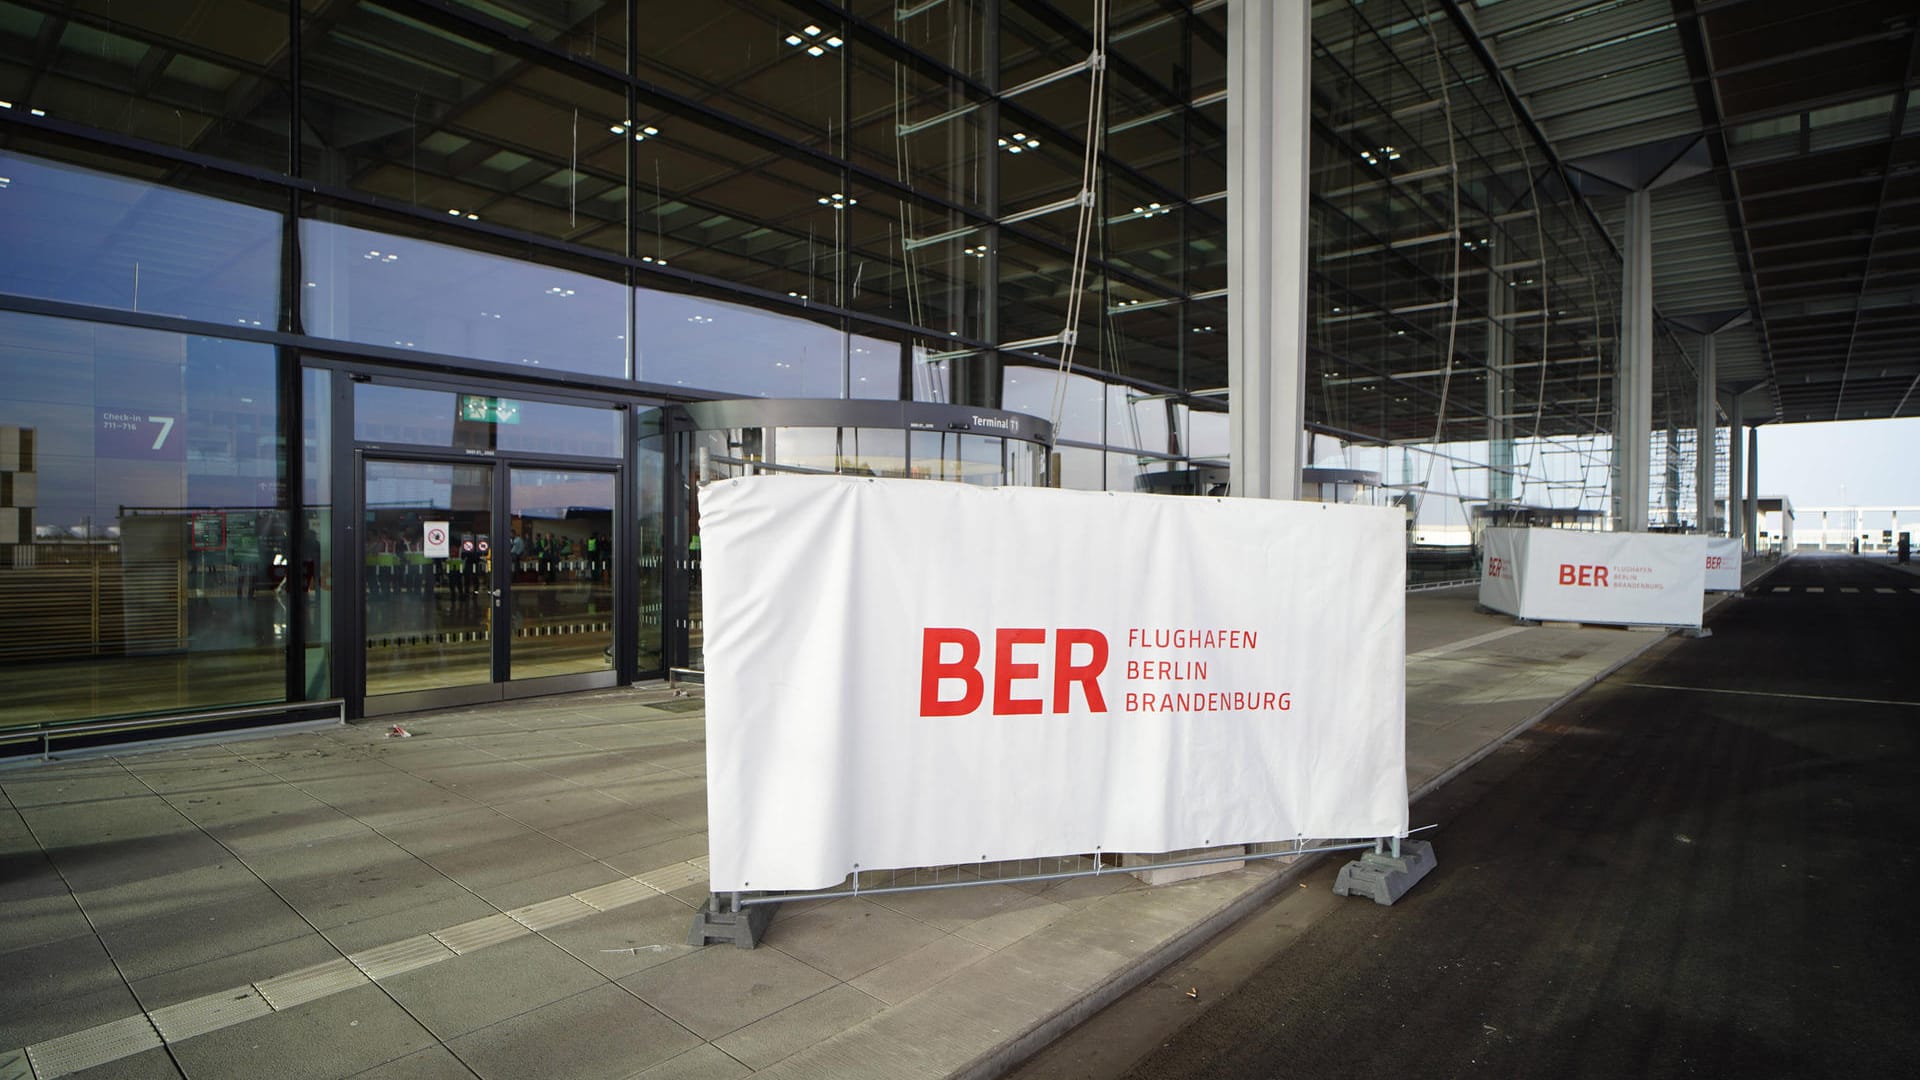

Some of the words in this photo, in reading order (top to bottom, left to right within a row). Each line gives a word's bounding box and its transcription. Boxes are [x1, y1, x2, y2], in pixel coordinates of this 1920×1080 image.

[103, 412, 141, 422] Check-in
[972, 415, 1009, 429] Terminal
[1010, 418, 1019, 431] T1
[148, 415, 175, 450] 7
[1706, 556, 1721, 570] BER
[1558, 563, 1609, 588] BER
[1128, 629, 1258, 649] FLUGHAFEN
[919, 627, 1109, 718] BER
[1127, 661, 1208, 681] BERLIN
[1125, 692, 1292, 713] BRANDENBURG
